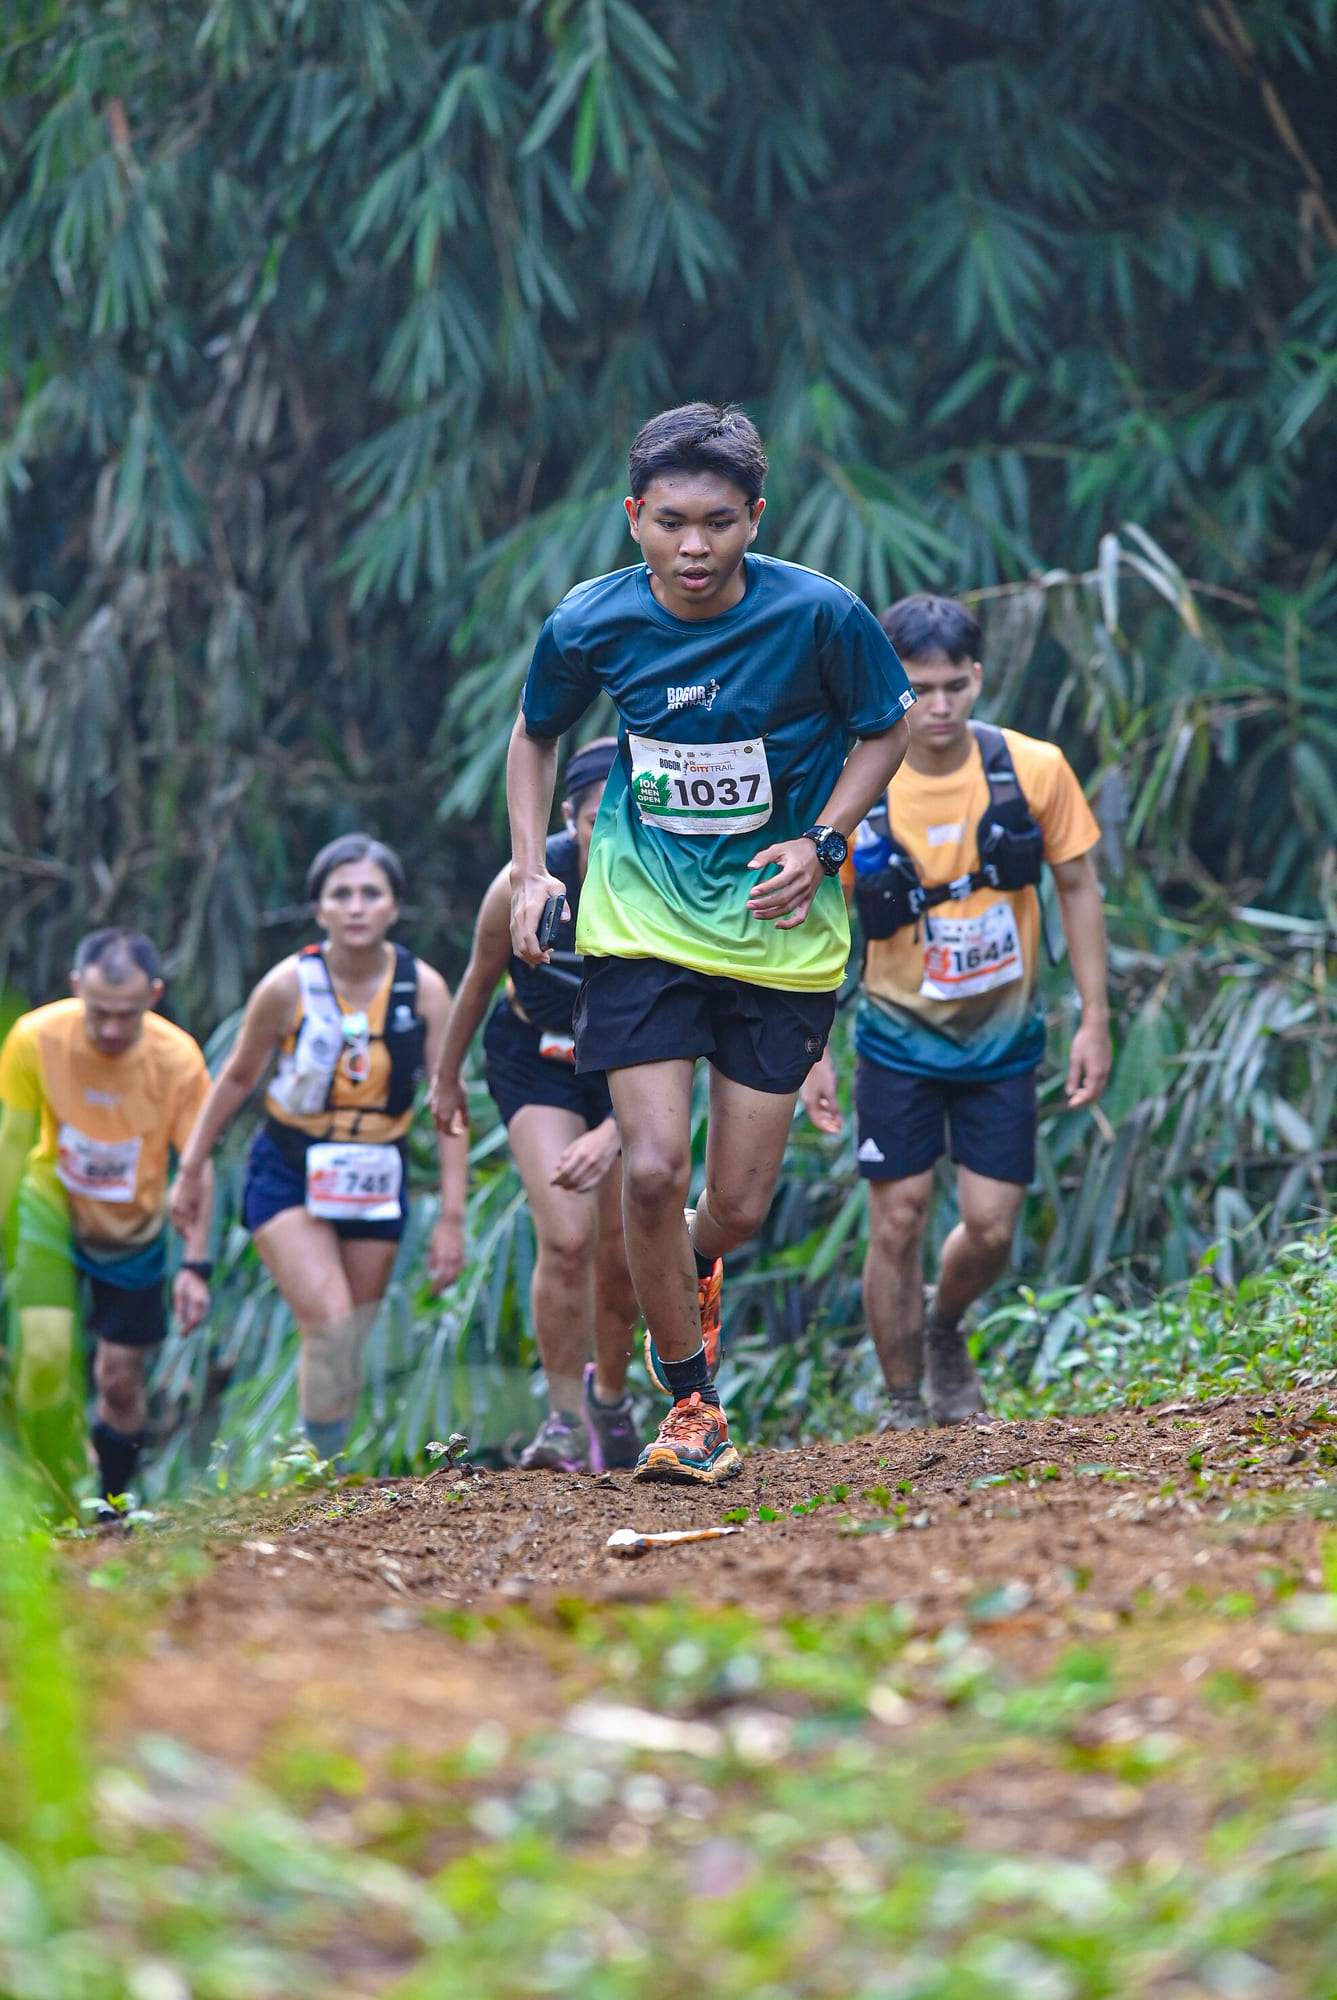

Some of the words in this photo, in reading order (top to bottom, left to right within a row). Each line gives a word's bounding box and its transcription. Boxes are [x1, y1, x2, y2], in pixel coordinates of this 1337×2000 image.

[667, 686, 706, 703] BOGOR
[659, 758, 681, 771] BOGOR
[710, 763, 736, 772] TRAIL
[639, 779, 658, 790] 10K
[674, 773, 761, 806] 1037
[637, 794, 661, 803] OPEN
[640, 788, 660, 797] MEN
[953, 932, 1015, 972] 1644
